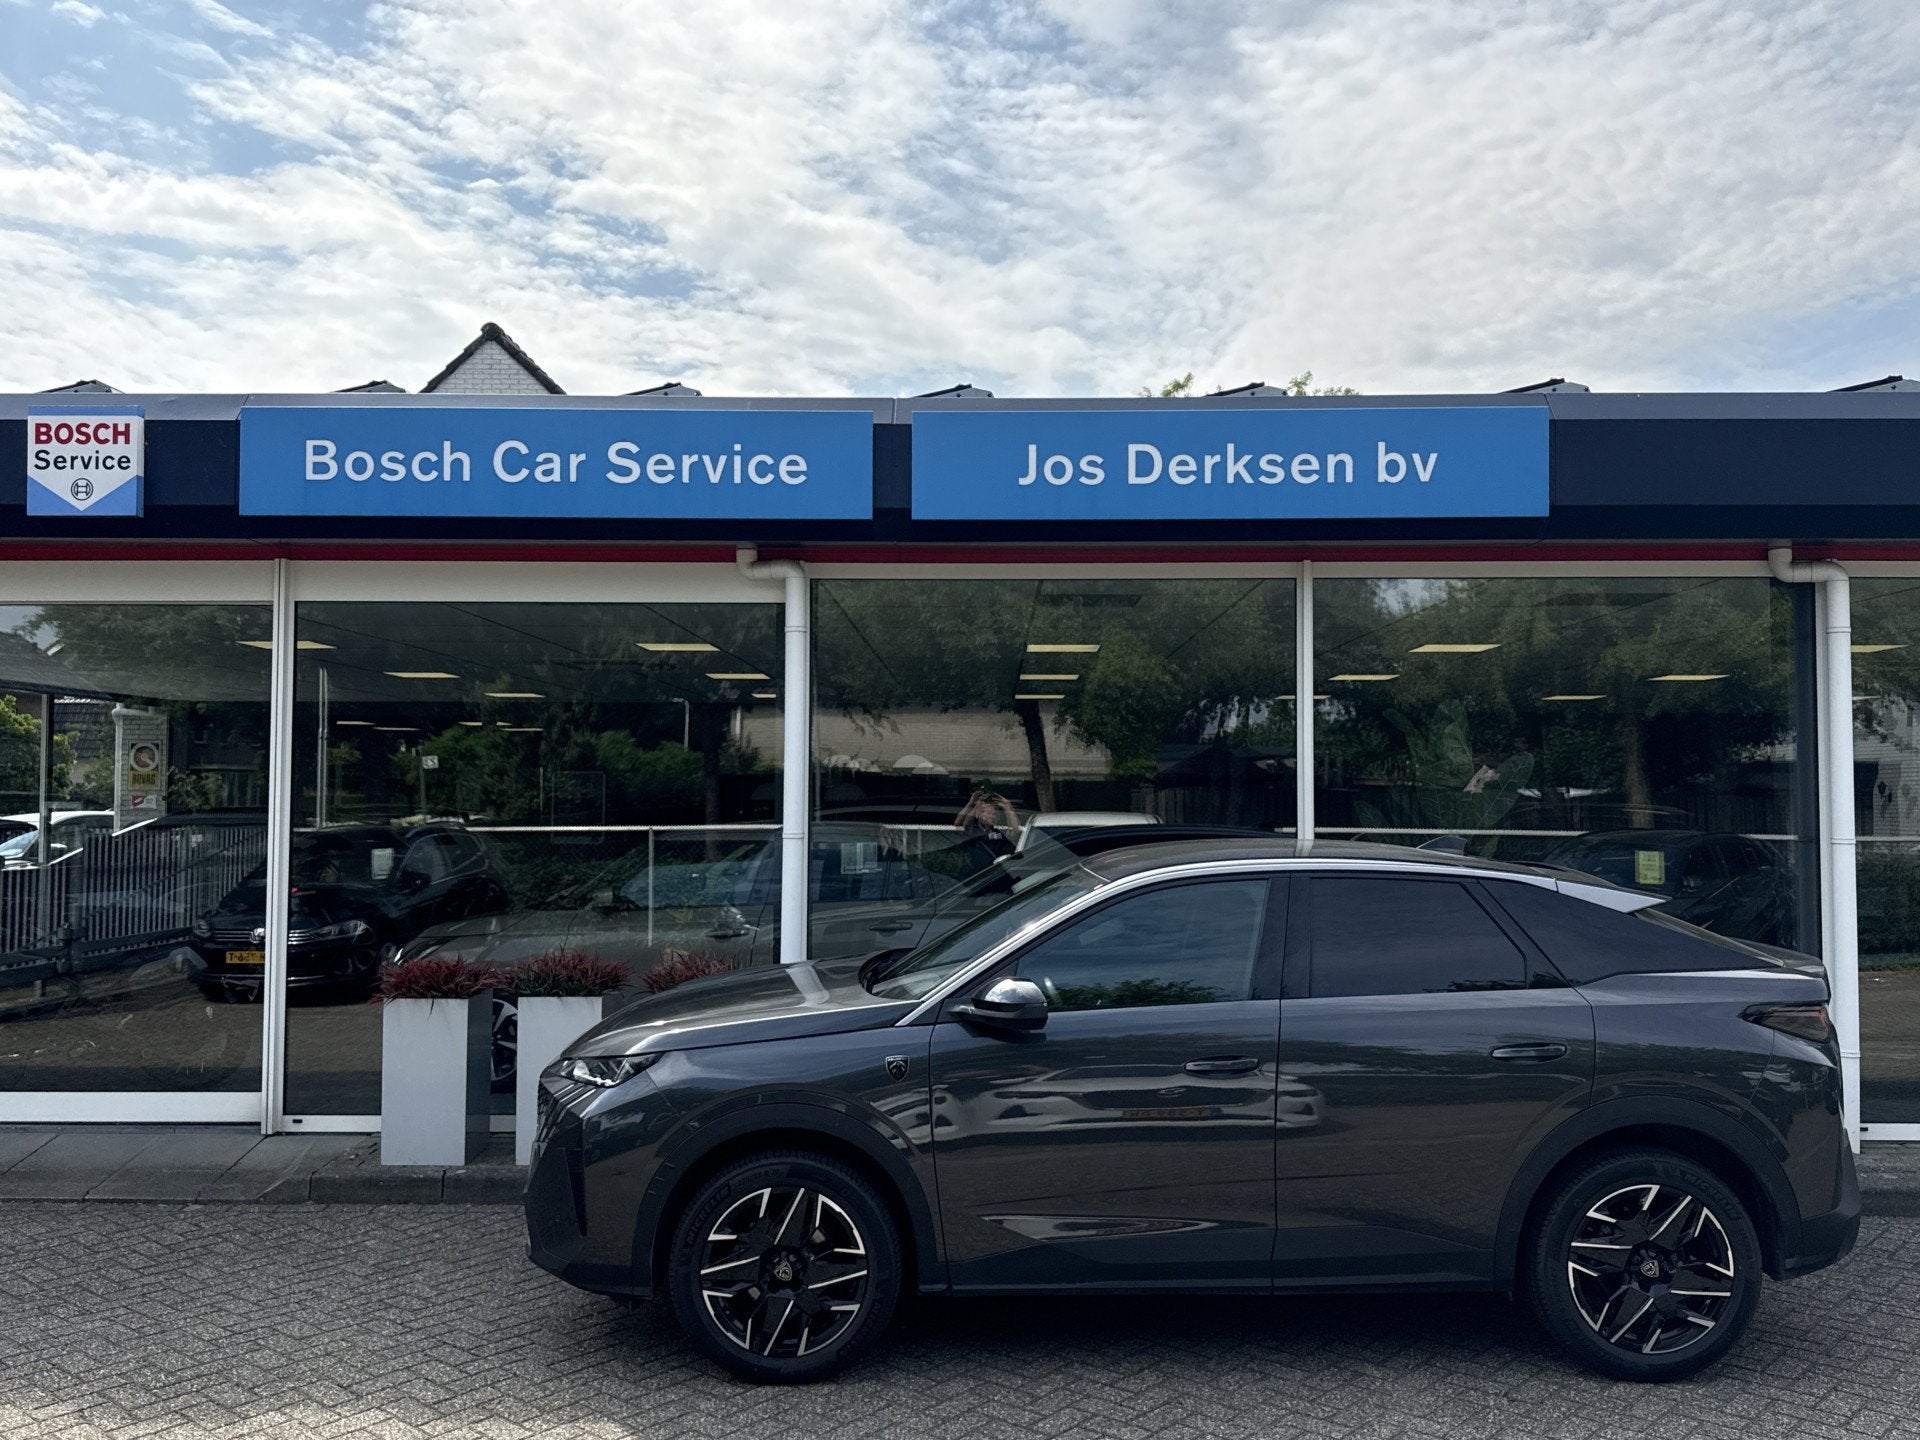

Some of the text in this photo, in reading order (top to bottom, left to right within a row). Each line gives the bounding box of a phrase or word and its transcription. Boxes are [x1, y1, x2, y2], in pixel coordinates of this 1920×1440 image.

[34, 423, 131, 445] BOSCH
[34, 449, 131, 471] Service
[305, 439, 808, 485] Bosch Car Service
[1018, 441, 1438, 486] Jos Derksen bv
[686, 1180, 732, 1246] MICHELIN
